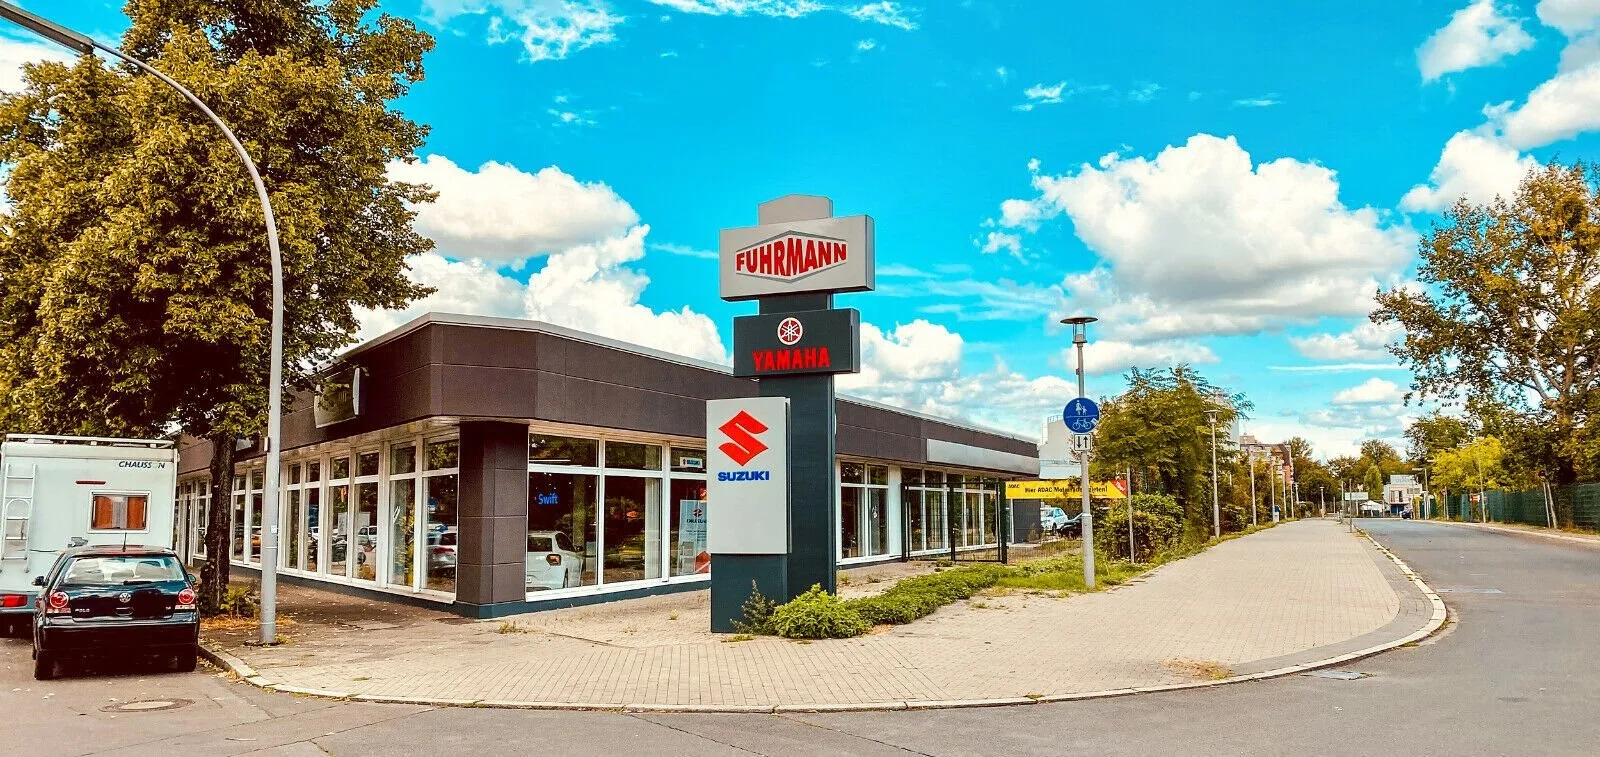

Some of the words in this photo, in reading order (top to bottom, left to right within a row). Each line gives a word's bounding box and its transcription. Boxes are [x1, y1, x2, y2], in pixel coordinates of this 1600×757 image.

[736, 237, 848, 277] FUHRMANN
[752, 346, 830, 372] YAMAHA
[118, 461, 166, 469] CHAUSSN
[717, 470, 770, 482] SUZUKI
[538, 491, 558, 505] Swift
